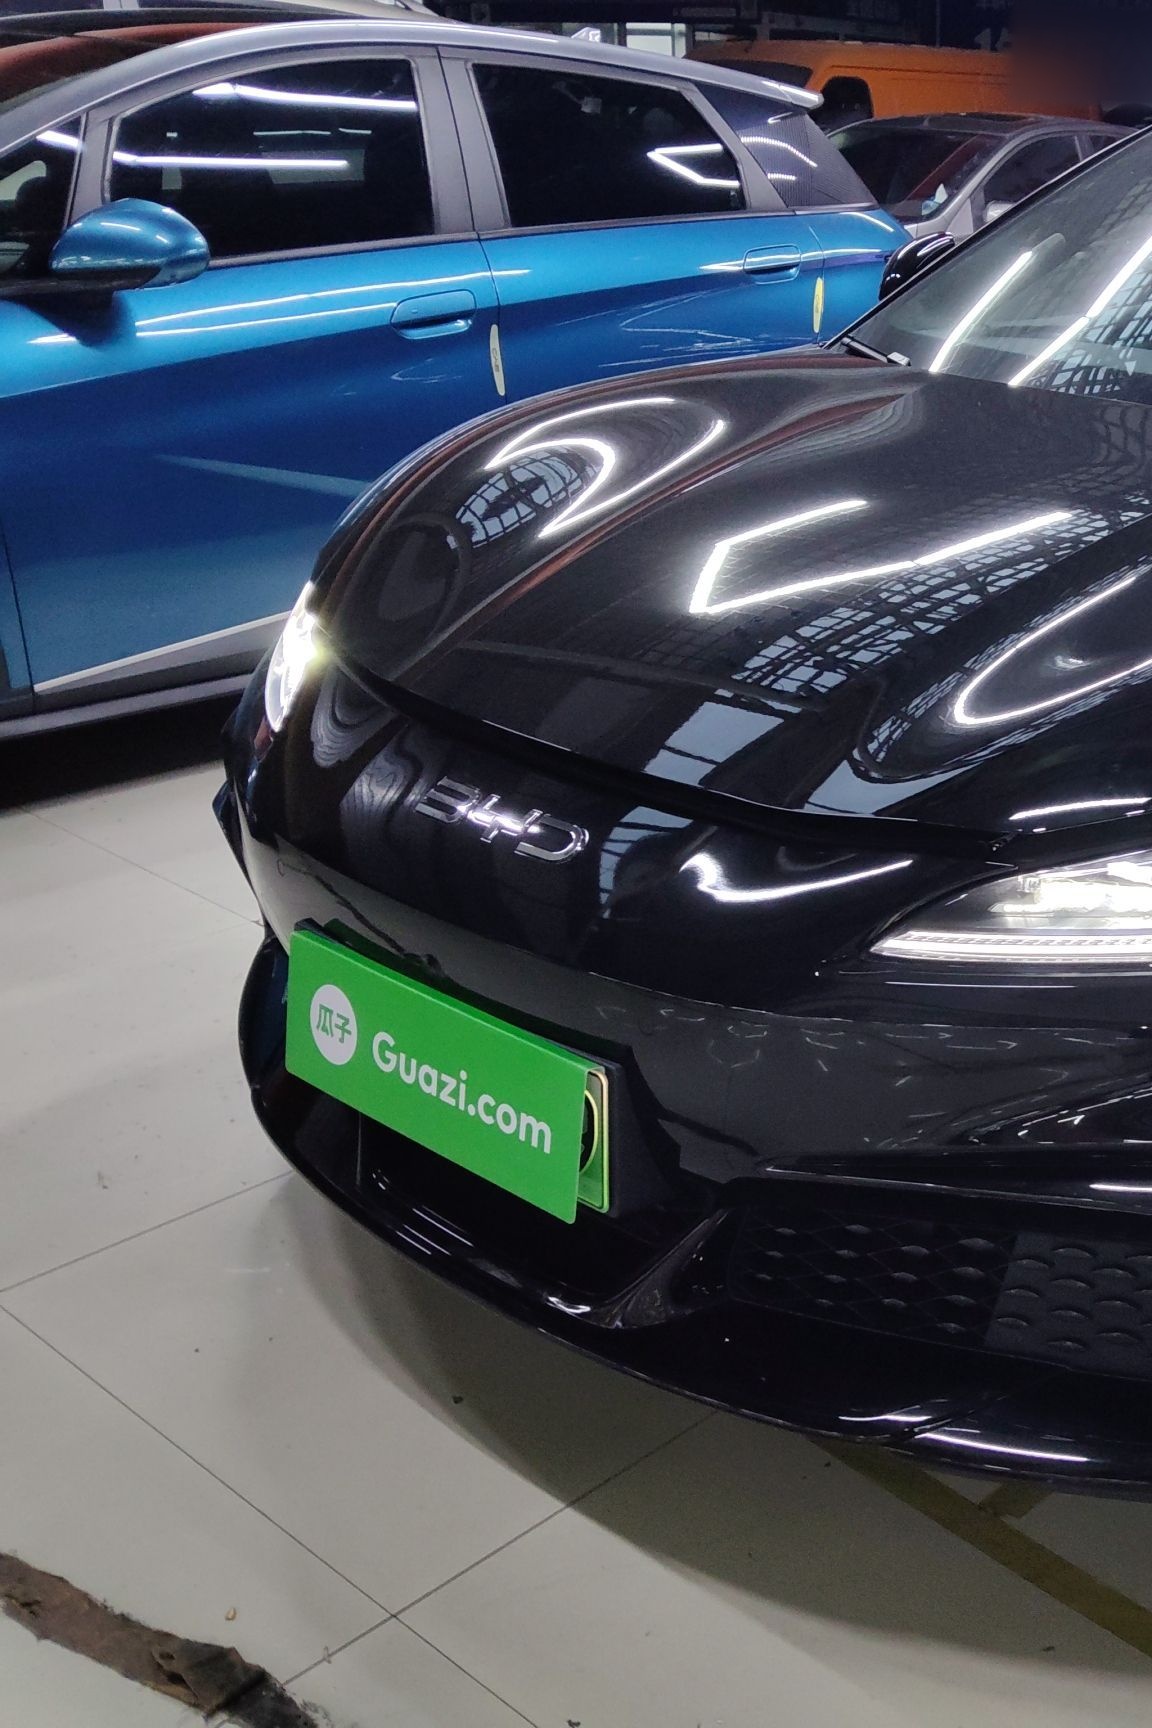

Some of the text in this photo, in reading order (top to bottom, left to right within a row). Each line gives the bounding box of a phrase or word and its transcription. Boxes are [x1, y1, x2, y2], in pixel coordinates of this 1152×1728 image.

[414, 776, 590, 864] BYD
[316, 1003, 352, 1044] 瓜子
[372, 1031, 552, 1154] Guazi.com
